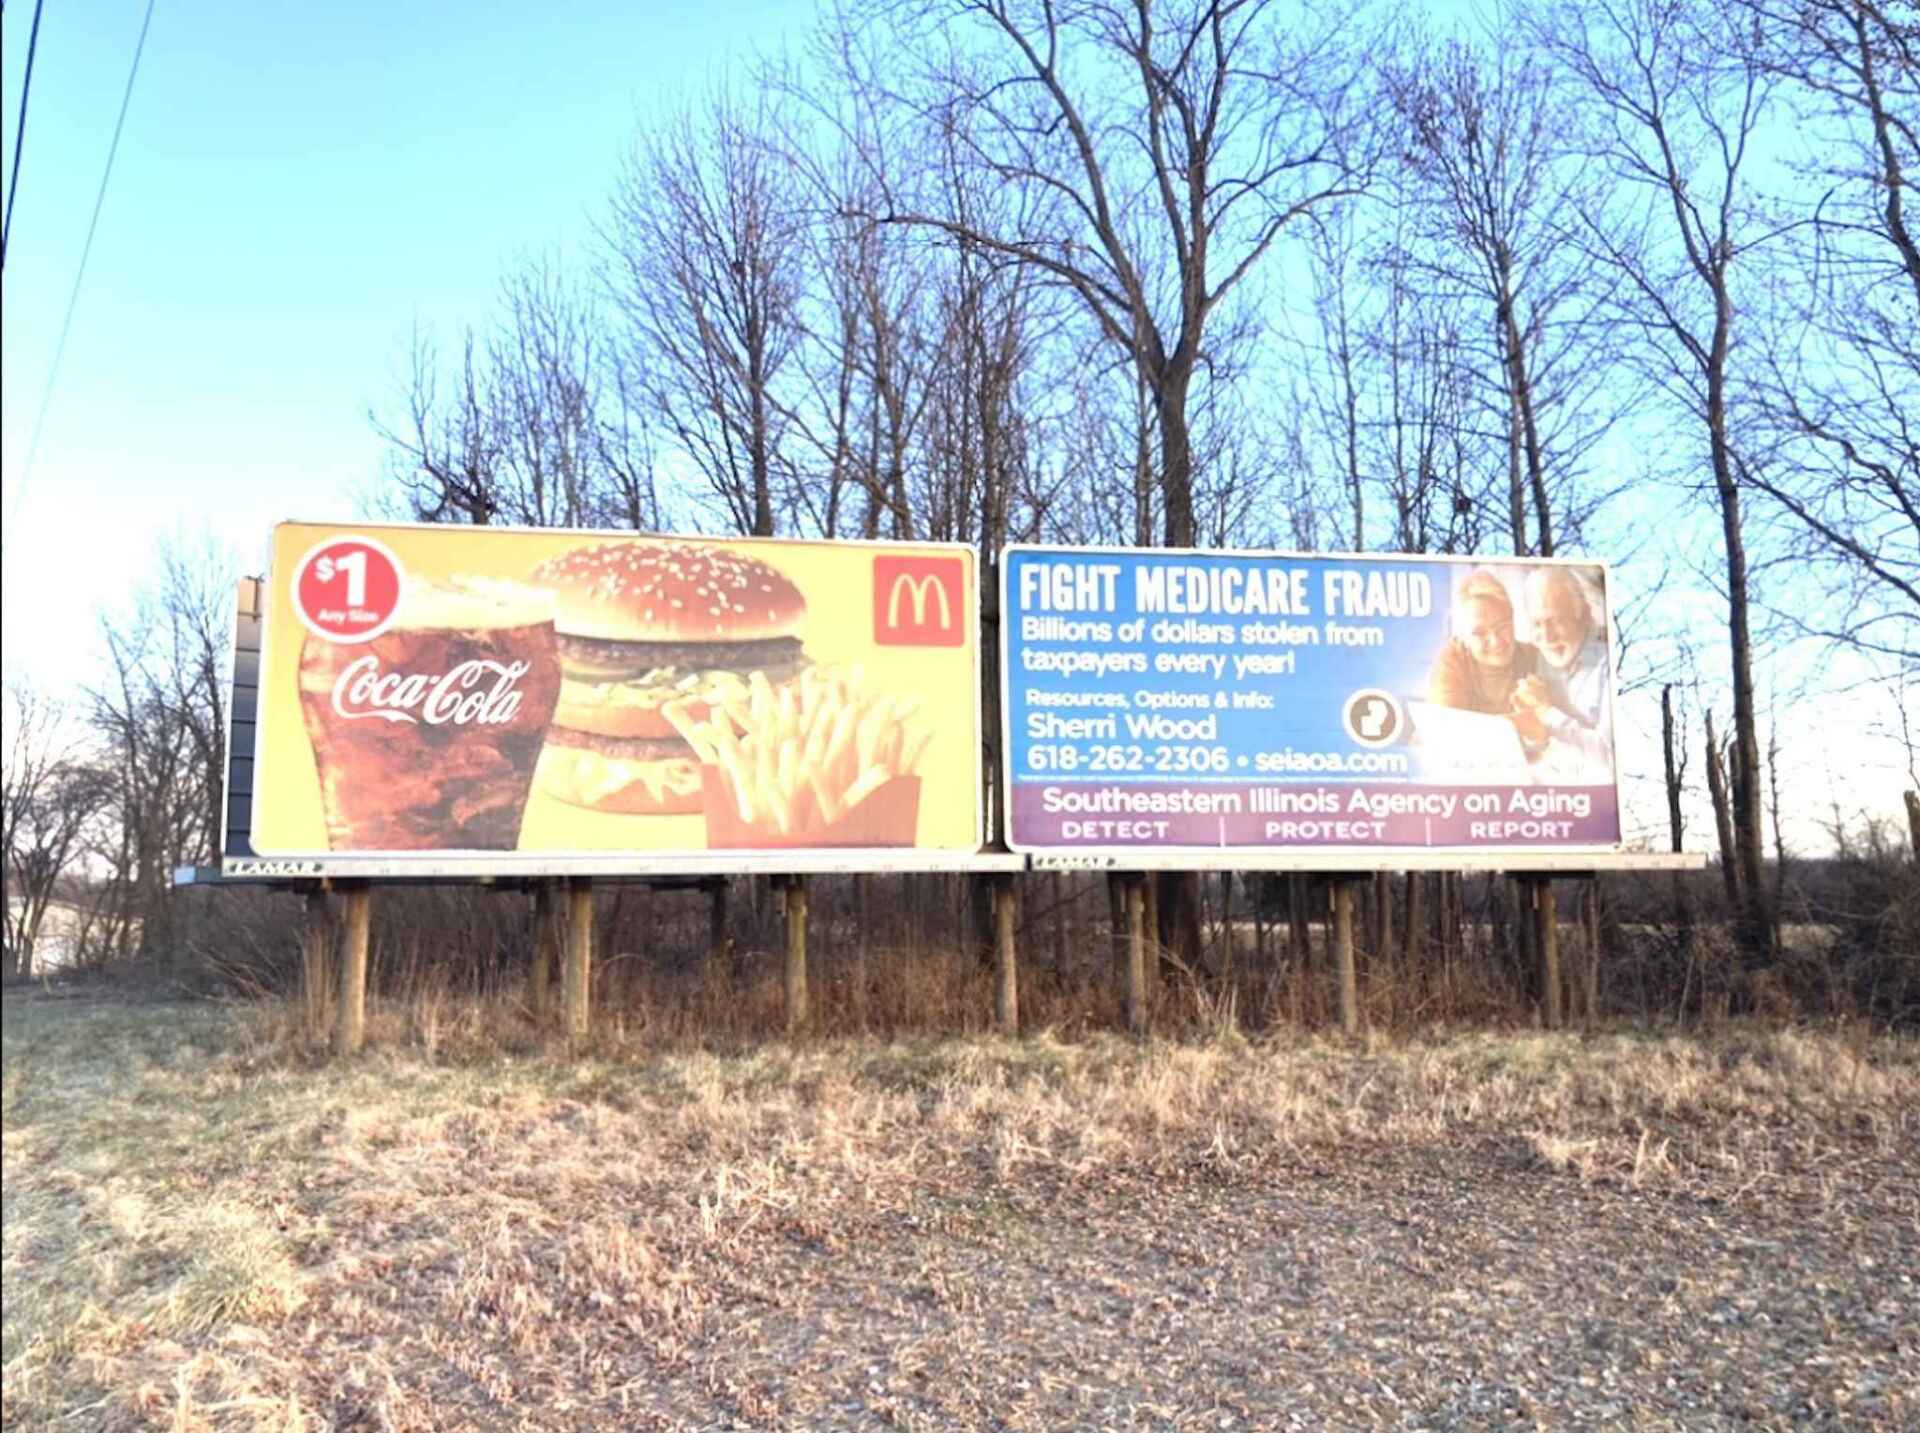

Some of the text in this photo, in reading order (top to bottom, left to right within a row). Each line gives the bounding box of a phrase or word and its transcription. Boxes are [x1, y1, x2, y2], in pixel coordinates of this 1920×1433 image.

[1020, 564, 1431, 617] FIGHT MEDICARE FRAUD
[318, 609, 379, 624] Any Size
[1021, 616, 1383, 646] Billions of dollars stolen from
[1021, 647, 1295, 679] taxpayers every year!
[332, 655, 531, 725] Coca-Cola
[1025, 688, 1275, 709] Resources, Options & Info:
[1027, 712, 1216, 740] Sherri Wood
[1027, 745, 1408, 773] 618-262-2306 seiaoa.com
[1042, 786, 1591, 818] Southeastern Illinois Agency on Aging
[1061, 821, 1573, 839] DETECT PROTECT REPORT
